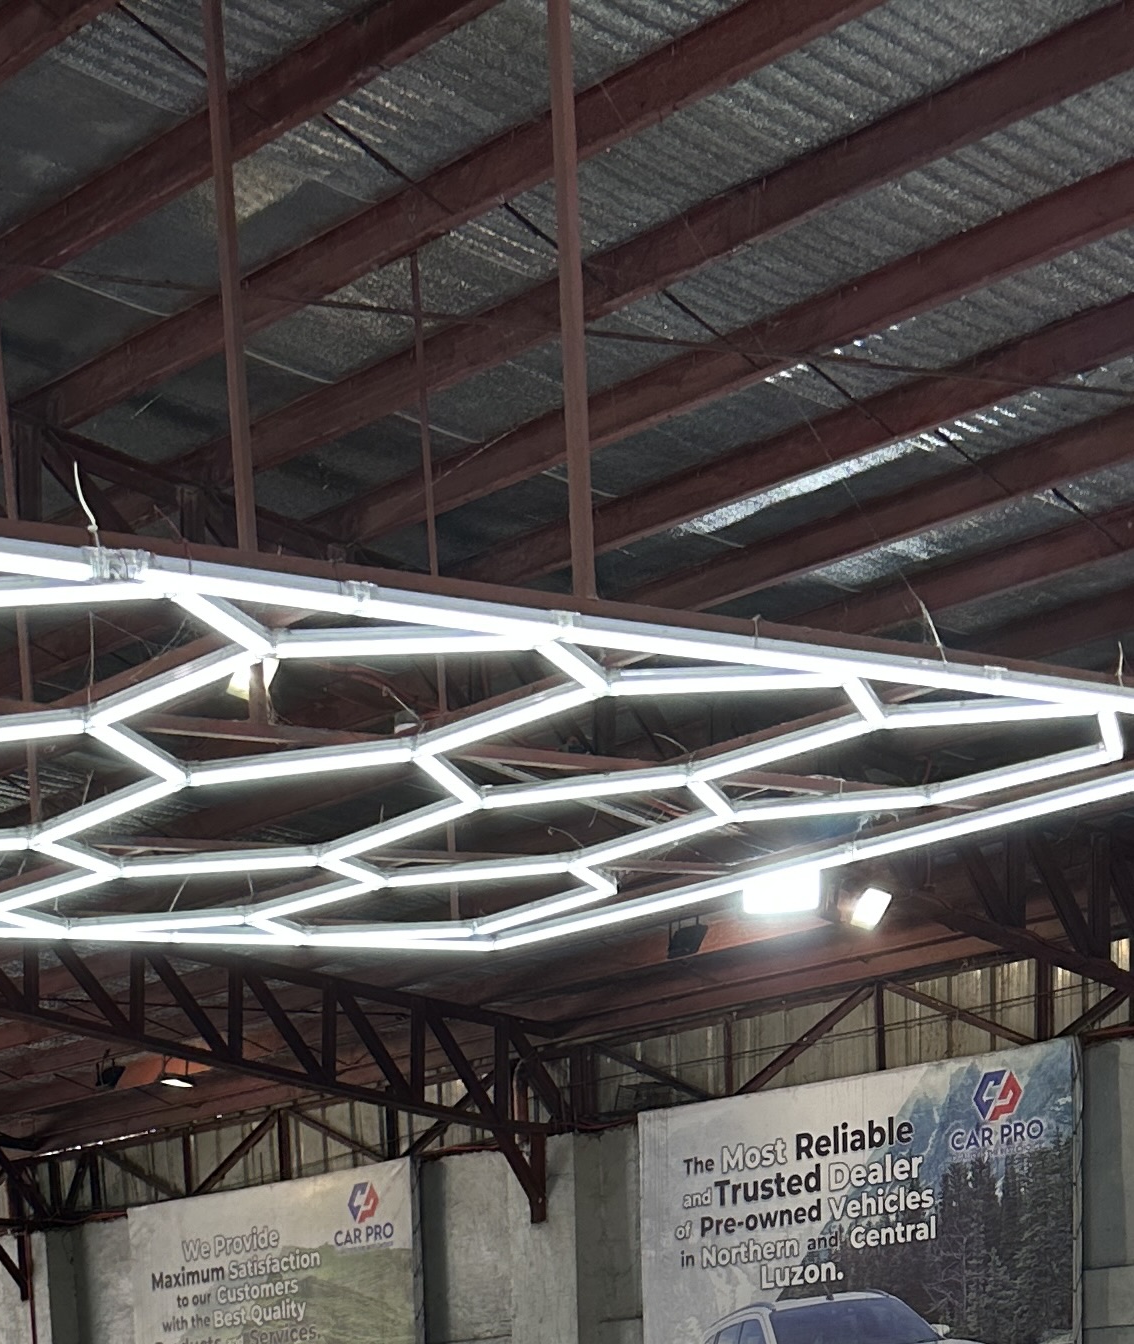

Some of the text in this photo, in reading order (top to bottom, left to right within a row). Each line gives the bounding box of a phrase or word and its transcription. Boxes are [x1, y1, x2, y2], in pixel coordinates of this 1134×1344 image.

[683, 1156, 715, 1177] The
[721, 1137, 788, 1175] Most
[795, 1116, 914, 1161] Reliable
[951, 1119, 1044, 1151] CAR PRO
[683, 1187, 712, 1209] and
[714, 1162, 822, 1207] Trusted
[828, 1153, 924, 1192] Dealer
[674, 1186, 935, 1241] of Pre-owned Vehicles
[181, 1226, 280, 1263] We Provide
[334, 1222, 394, 1247] CAR PRO
[680, 1215, 937, 1269] in Northern and Central
[151, 1249, 321, 1291] Maximum Satisfaction
[760, 1260, 845, 1291] Luzon.
[177, 1278, 299, 1308] to our Customers
[162, 1299, 306, 1333] with the Best Quality
